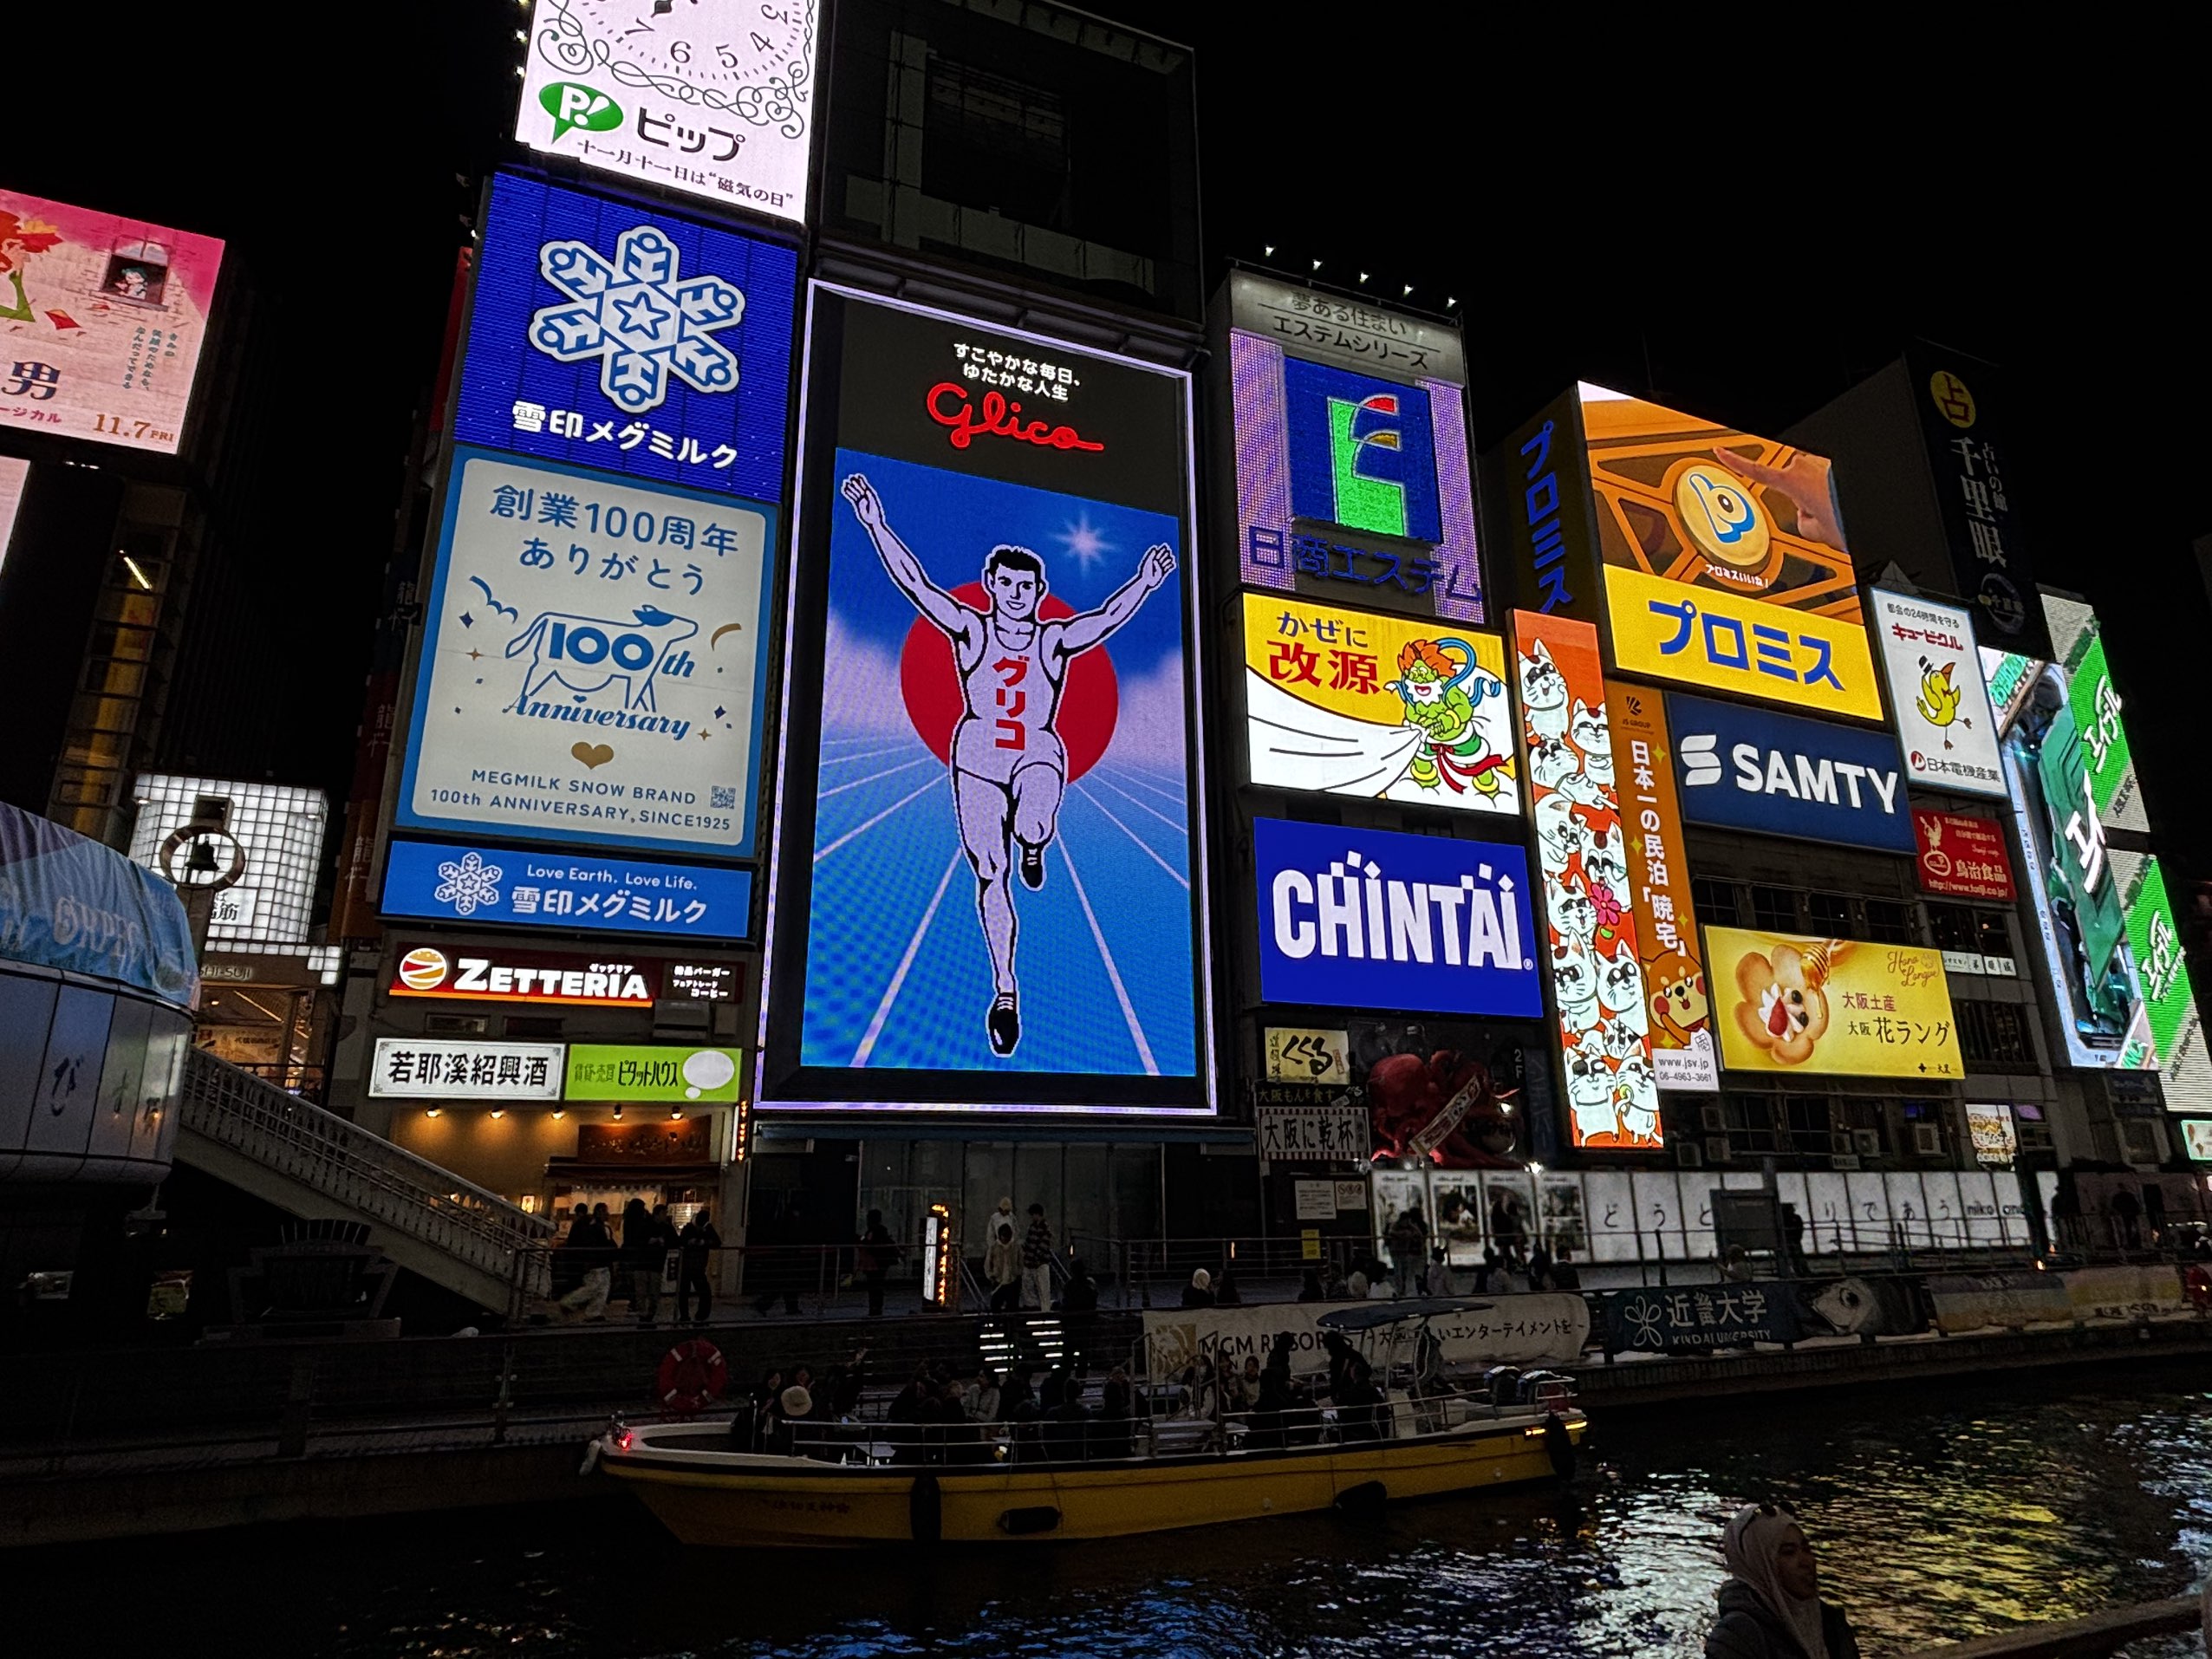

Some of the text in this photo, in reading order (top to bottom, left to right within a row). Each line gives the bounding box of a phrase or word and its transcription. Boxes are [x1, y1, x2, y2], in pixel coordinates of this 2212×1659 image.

[670, 41, 691, 63] 6
[716, 44, 738, 68] 5
[750, 31, 775, 52] 4
[637, 107, 746, 162] ピップ
[1290, 290, 1408, 336] 夢ある住まい
[1273, 315, 1429, 370] エステムシリーズ
[953, 342, 1081, 387] すこやかな毎日、
[963, 362, 1069, 403] ゆたかな人生
[93, 413, 174, 442] 11.7 FRI
[511, 400, 738, 471] 雪印メグミルク
[927, 382, 1104, 452] Glico
[490, 483, 739, 557] 創業100周年
[1520, 420, 1573, 614] プロミス
[518, 535, 705, 598] ありがとう
[1248, 524, 1483, 602] 日商エステム
[1277, 610, 1369, 648] かぜに
[1649, 599, 1847, 693] プロミス
[1891, 621, 1964, 652] キュービクル
[1266, 640, 1381, 695] 改源
[503, 693, 693, 742] Anniversary
[992, 655, 1030, 751] グリコ
[431, 788, 482, 808] 100th
[471, 770, 696, 806] MEGMILK SNOW BRAND
[1732, 743, 1898, 815] SAMTY
[526, 863, 698, 892] Love Earth. Love Life.
[511, 884, 707, 927] 雪印メグミルク
[1272, 850, 1523, 971] CHINTAI
[453, 958, 648, 999] ZETTERIA
[691, 988, 729, 999] コーヒー
[1842, 992, 1896, 1012] 大阪土産
[1848, 1016, 1950, 1047] 大阪 花ラング
[617, 1059, 679, 1088] ピタットハウス
[1281, 1035, 1334, 1077] くくる
[1658, 1057, 1708, 1070] www.jsv.jp
[1265, 1116, 1354, 1151] 大阪に乾杯
[1664, 1289, 1767, 1328] 近畿大学
